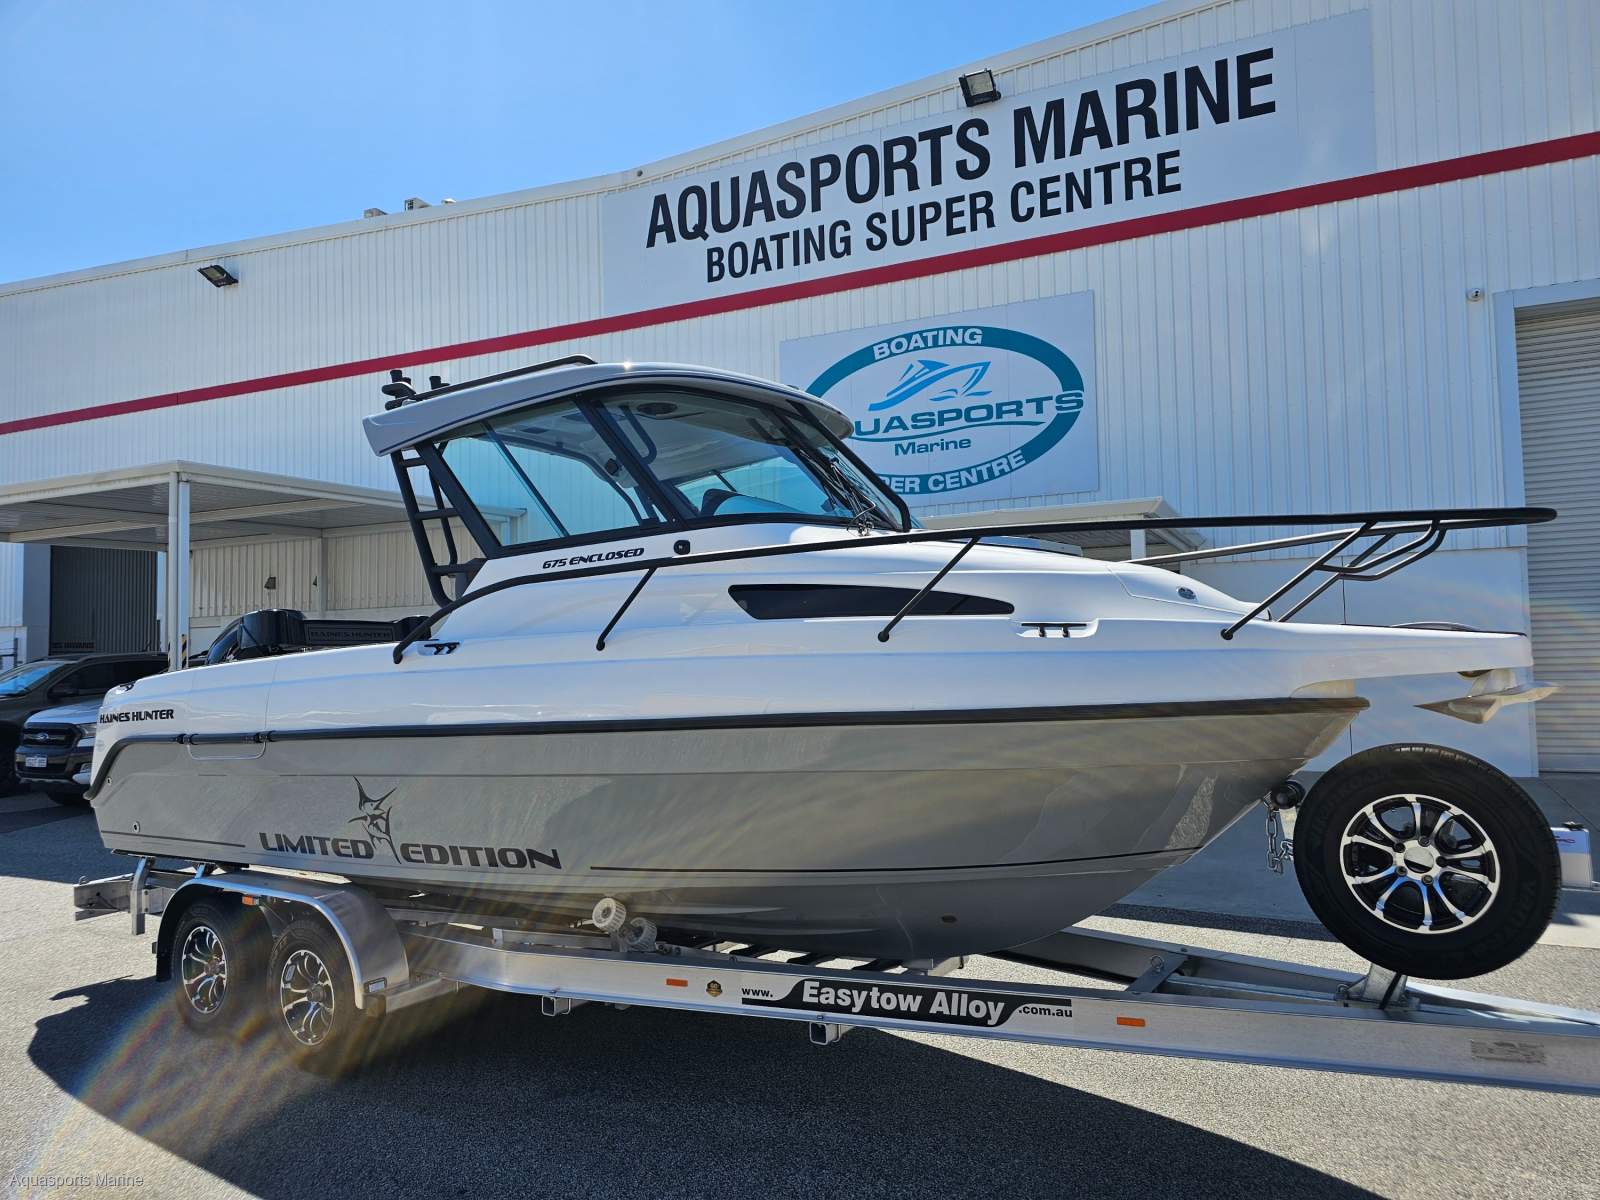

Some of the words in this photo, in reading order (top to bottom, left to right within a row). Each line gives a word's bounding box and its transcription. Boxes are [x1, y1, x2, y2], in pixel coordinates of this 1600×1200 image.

[646, 117, 991, 249] AQUASPORTS
[1013, 47, 1276, 169] MARINE
[706, 219, 852, 283] BOATING
[865, 190, 996, 252] SUPER
[1010, 149, 1182, 223] CENTRE
[873, 327, 984, 361] BOATING
[855, 392, 1084, 437] UASPORTS
[894, 438, 972, 457] Marine
[927, 450, 1027, 490] CENTRE
[543, 558, 568, 569] 675
[569, 547, 645, 566] ENCLOSED
[100, 712, 131, 724] HAINES
[132, 709, 175, 722] HUNTER
[259, 832, 375, 860] LIMITED
[400, 843, 563, 870] EDITION
[741, 988, 774, 999] www.
[802, 980, 924, 1015] Easytow
[929, 991, 1005, 1026] Alloy
[1018, 1004, 1073, 1019] .com.au
